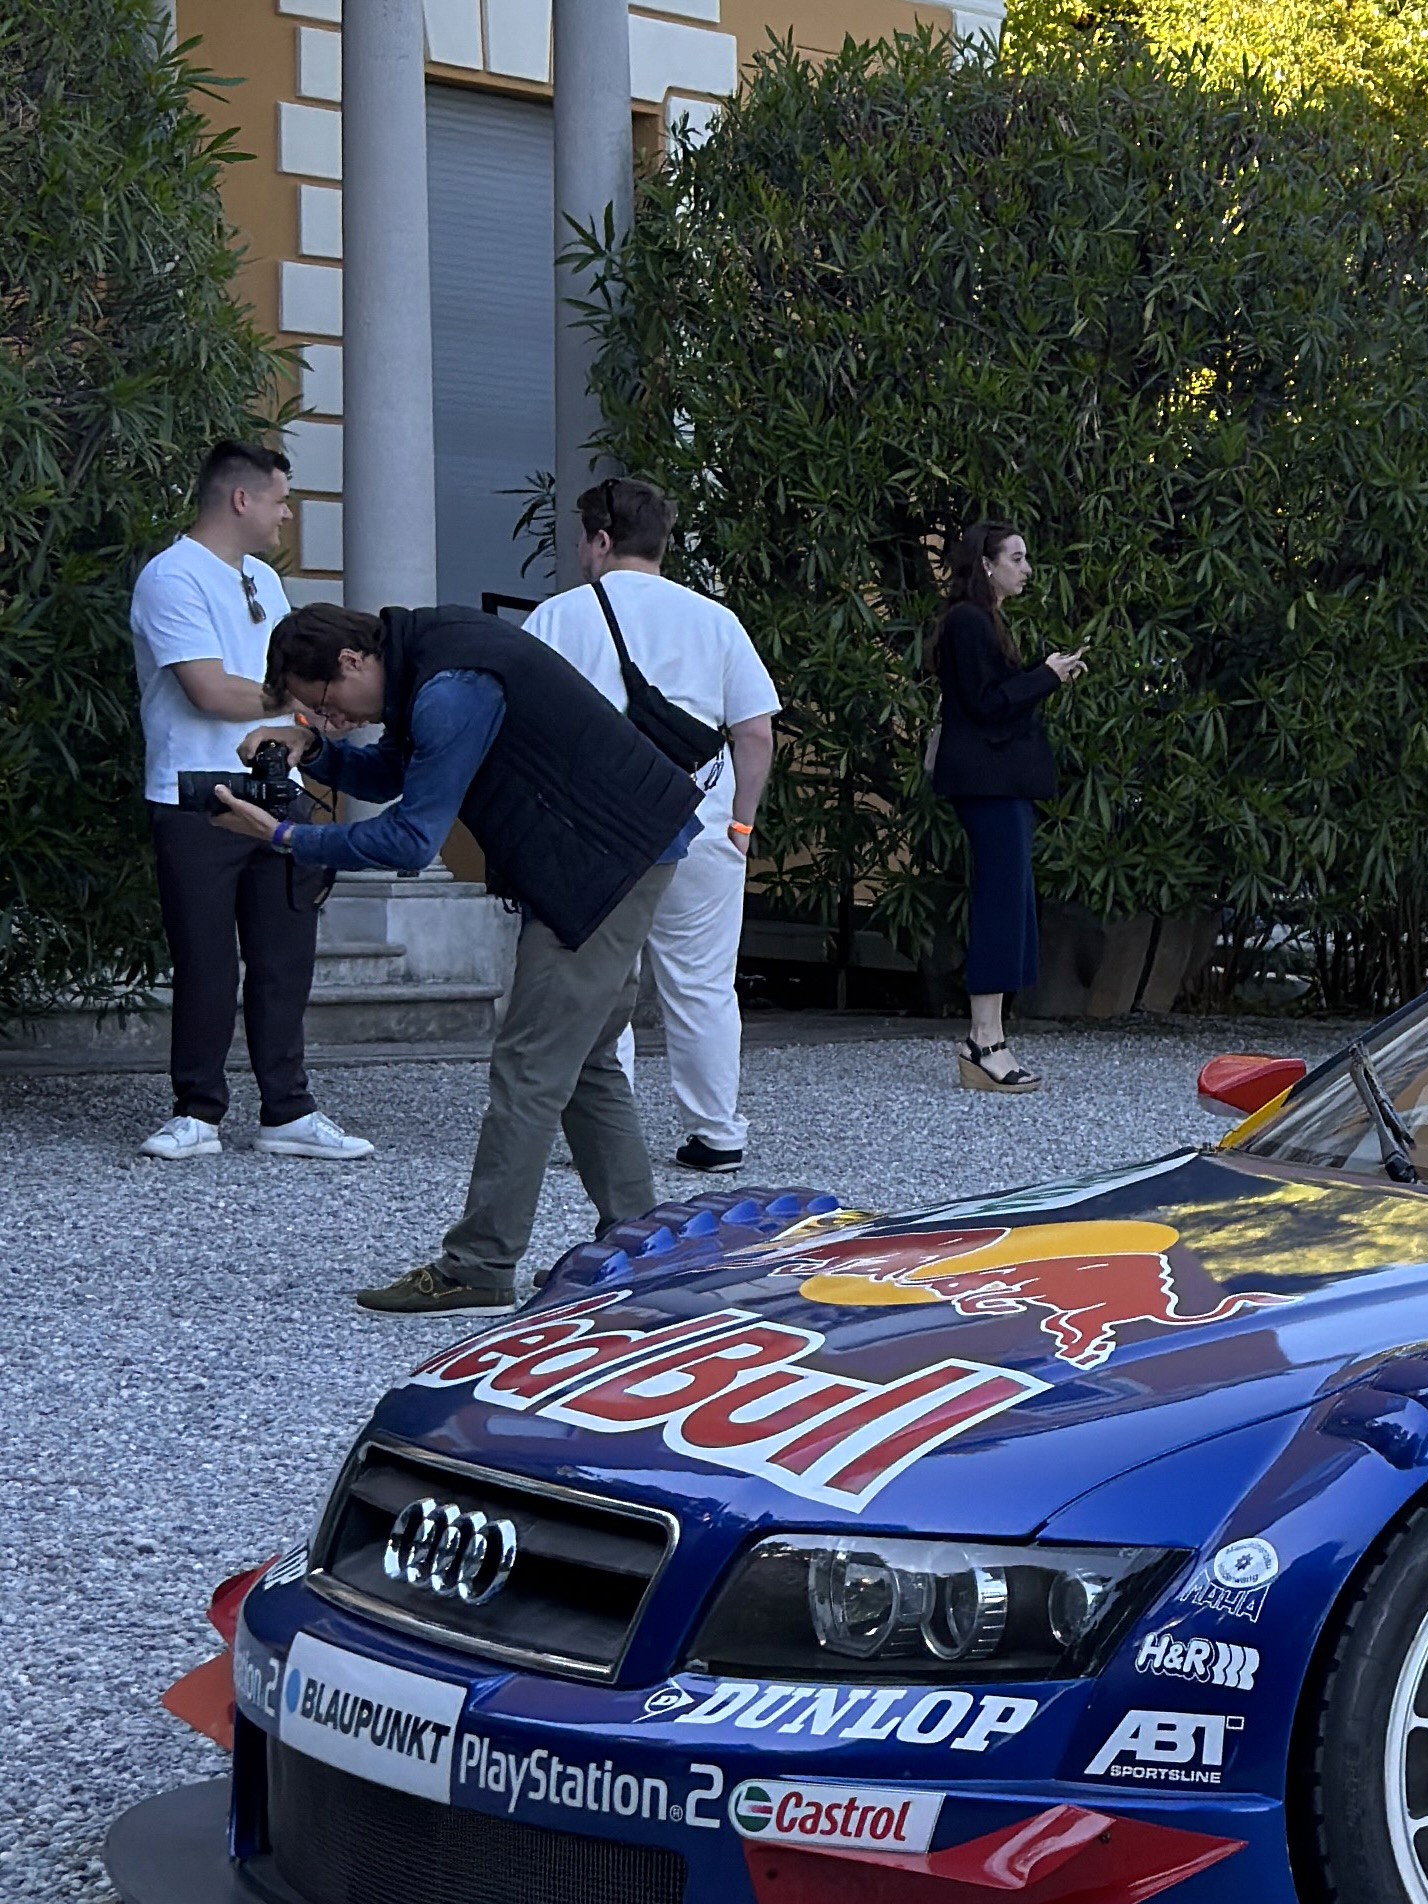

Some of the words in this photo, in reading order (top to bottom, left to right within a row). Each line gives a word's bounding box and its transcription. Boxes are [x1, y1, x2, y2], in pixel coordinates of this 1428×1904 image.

[1134, 1632, 1216, 1684] H&R
[300, 1678, 451, 1764] BLAUPUNKT
[674, 1684, 1039, 1752] DUNLOP
[1084, 1709, 1226, 1775] ABT
[1110, 1765, 1222, 1784] SPORTSLINE
[775, 1792, 910, 1842] Castrol
